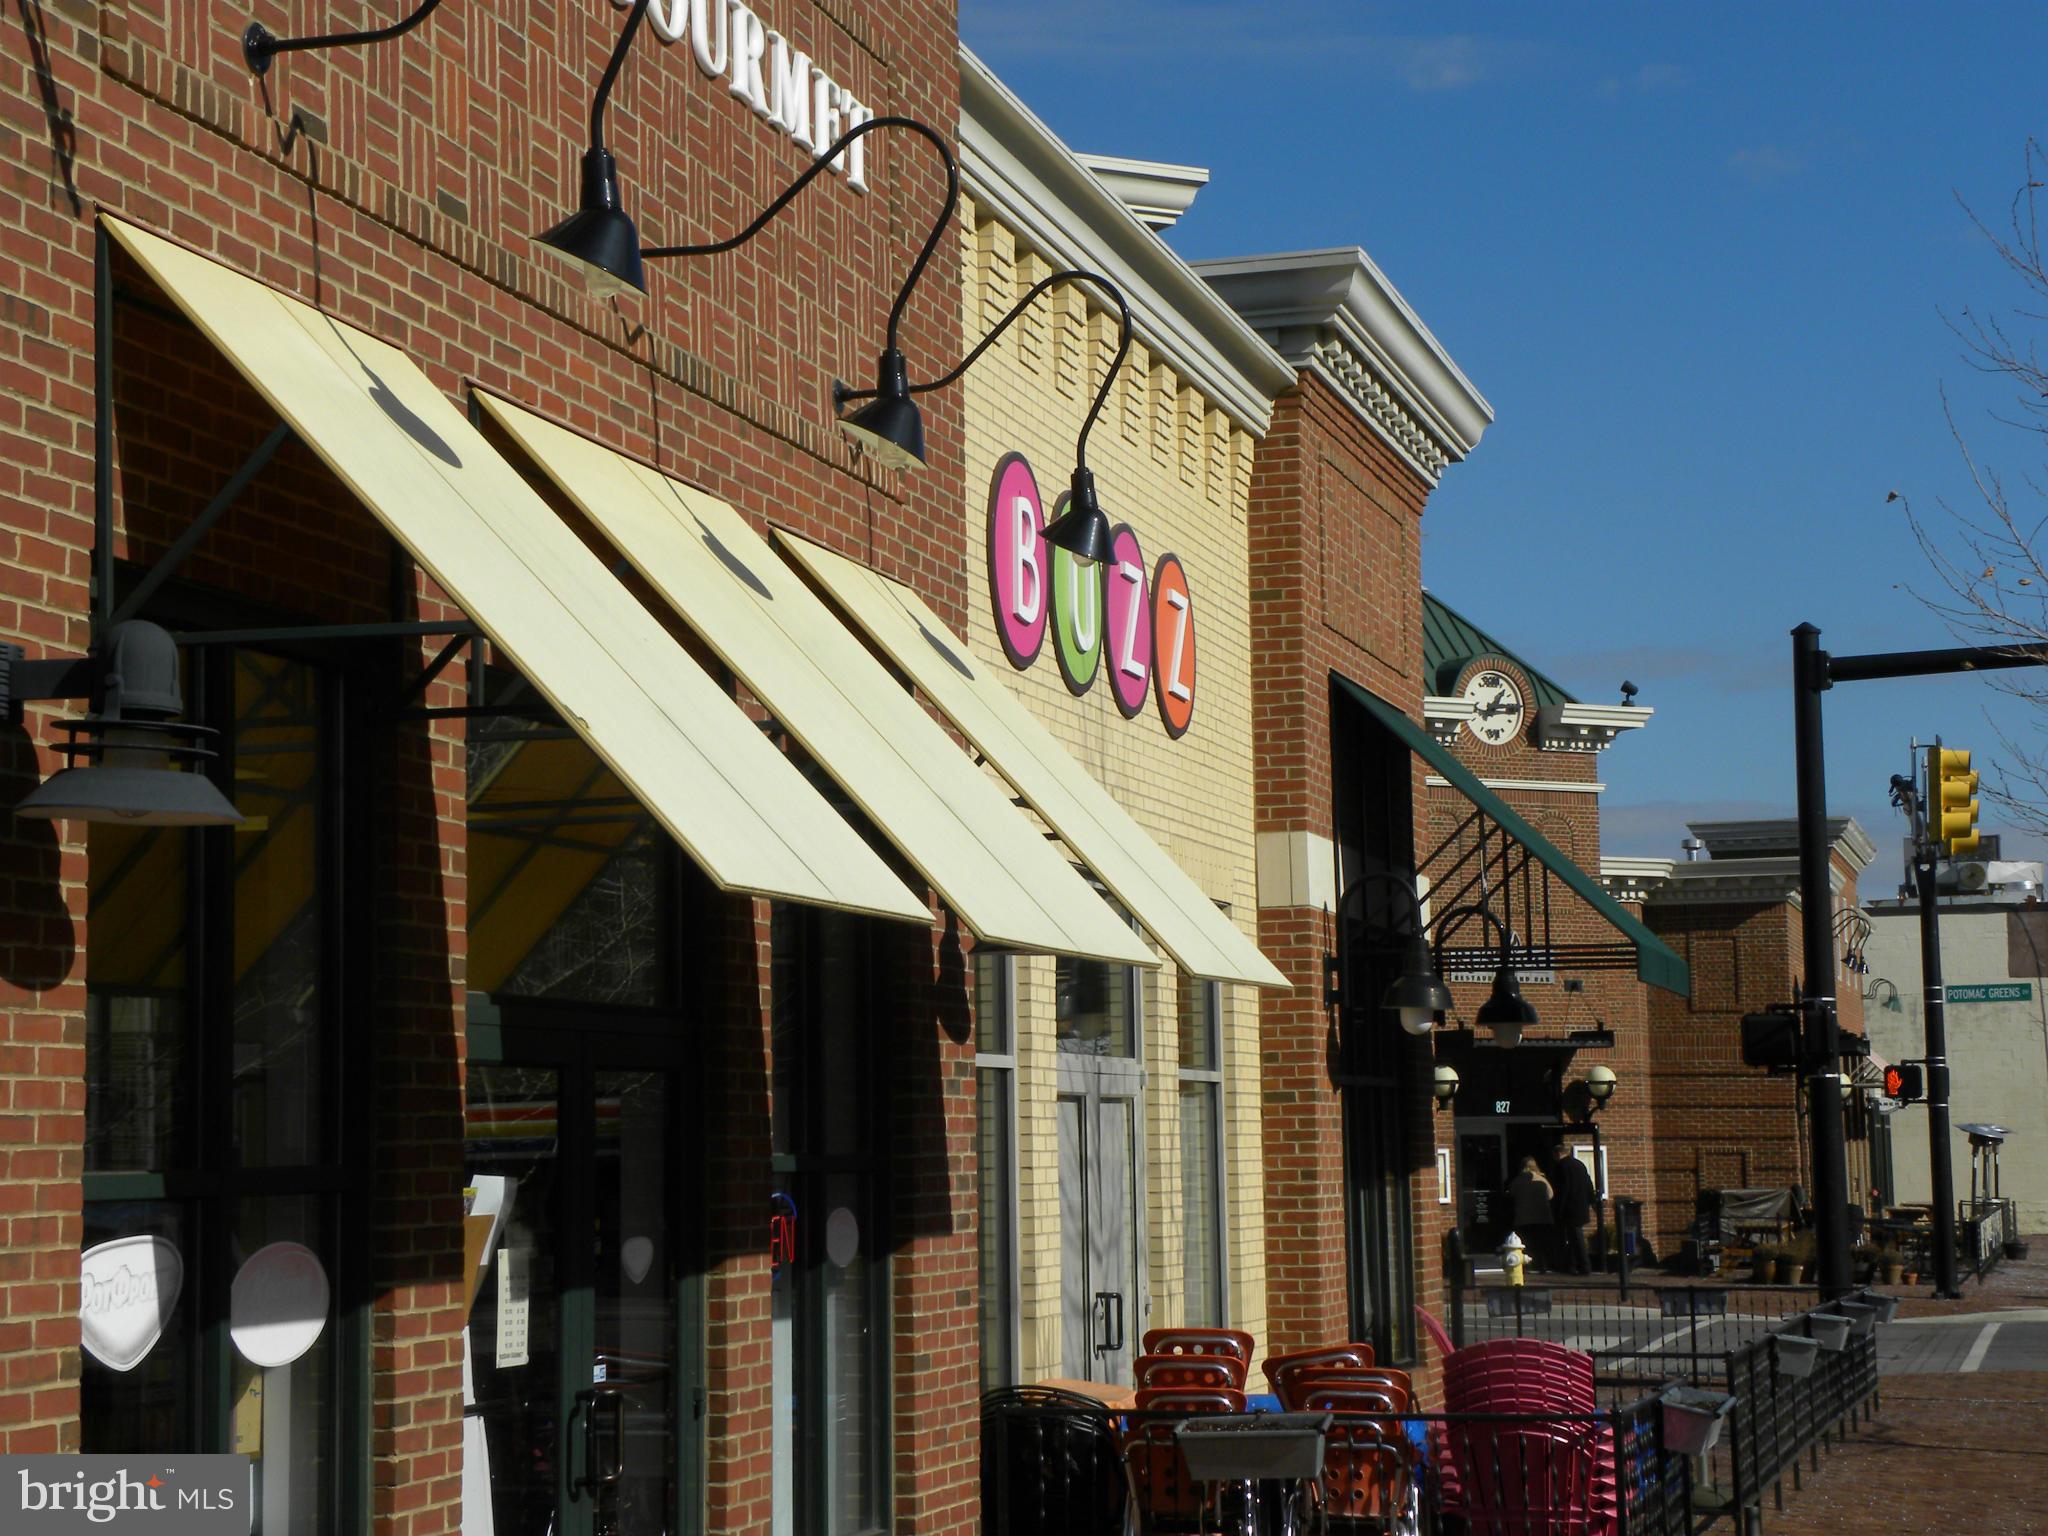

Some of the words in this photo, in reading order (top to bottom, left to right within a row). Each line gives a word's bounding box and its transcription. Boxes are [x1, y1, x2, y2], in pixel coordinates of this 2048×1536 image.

[1012, 497, 1191, 702] BUZZ
[1948, 989, 1986, 999] POTOMAC
[1988, 987, 2020, 998] GREENS
[1495, 1101, 1510, 1113] 827
